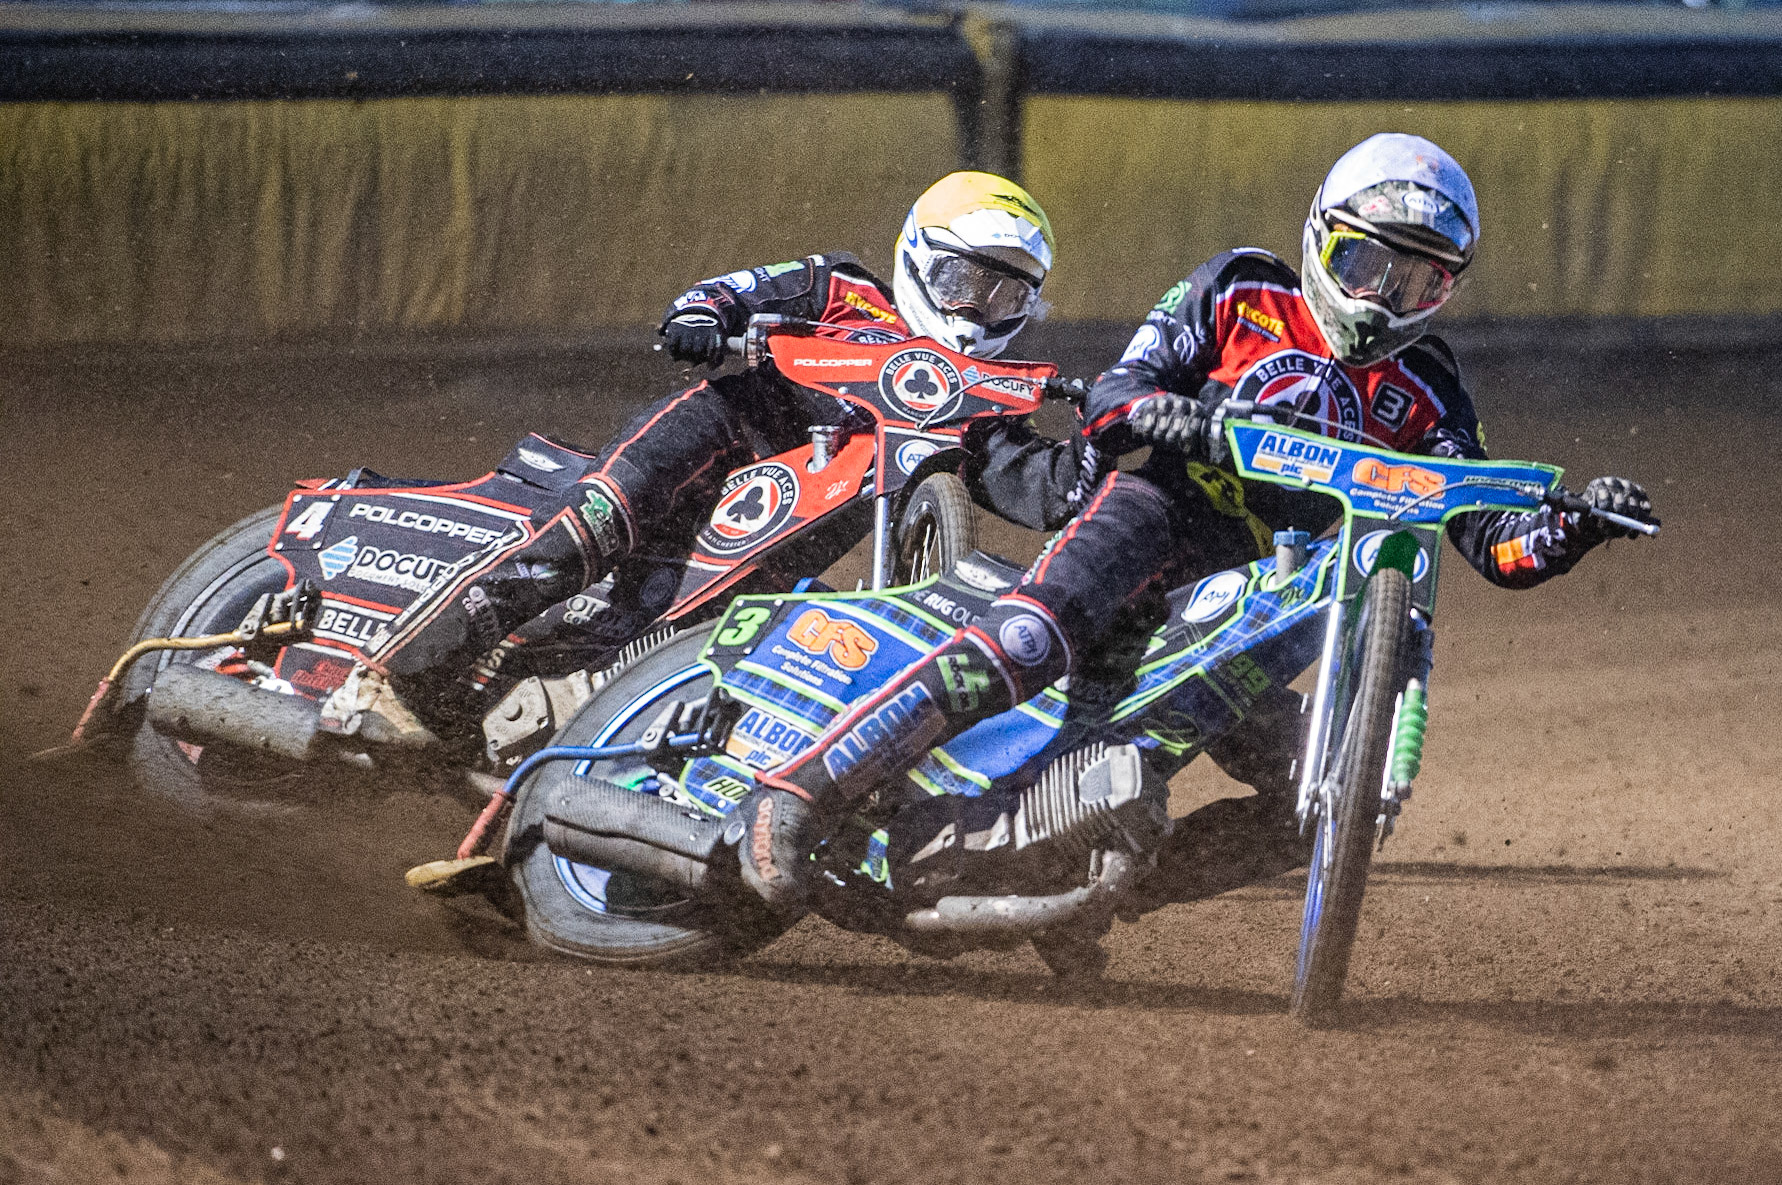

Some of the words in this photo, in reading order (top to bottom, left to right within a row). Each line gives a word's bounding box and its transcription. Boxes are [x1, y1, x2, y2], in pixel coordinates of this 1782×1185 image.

[793, 359, 872, 367] POLCOPPER
[886, 354, 911, 375] BELLE
[914, 352, 936, 363] VUE
[937, 362, 957, 384] ACES
[1256, 357, 1304, 383] BELLE
[1261, 434, 1339, 466] ALBON
[762, 466, 784, 479] VUE
[778, 476, 794, 505] ACES
[1352, 457, 1447, 499] CFS
[285, 502, 334, 540] 4
[923, 592, 956, 616] RUG
[317, 608, 387, 640] BELL
[718, 607, 771, 646] 3
[786, 608, 879, 671] CFS
